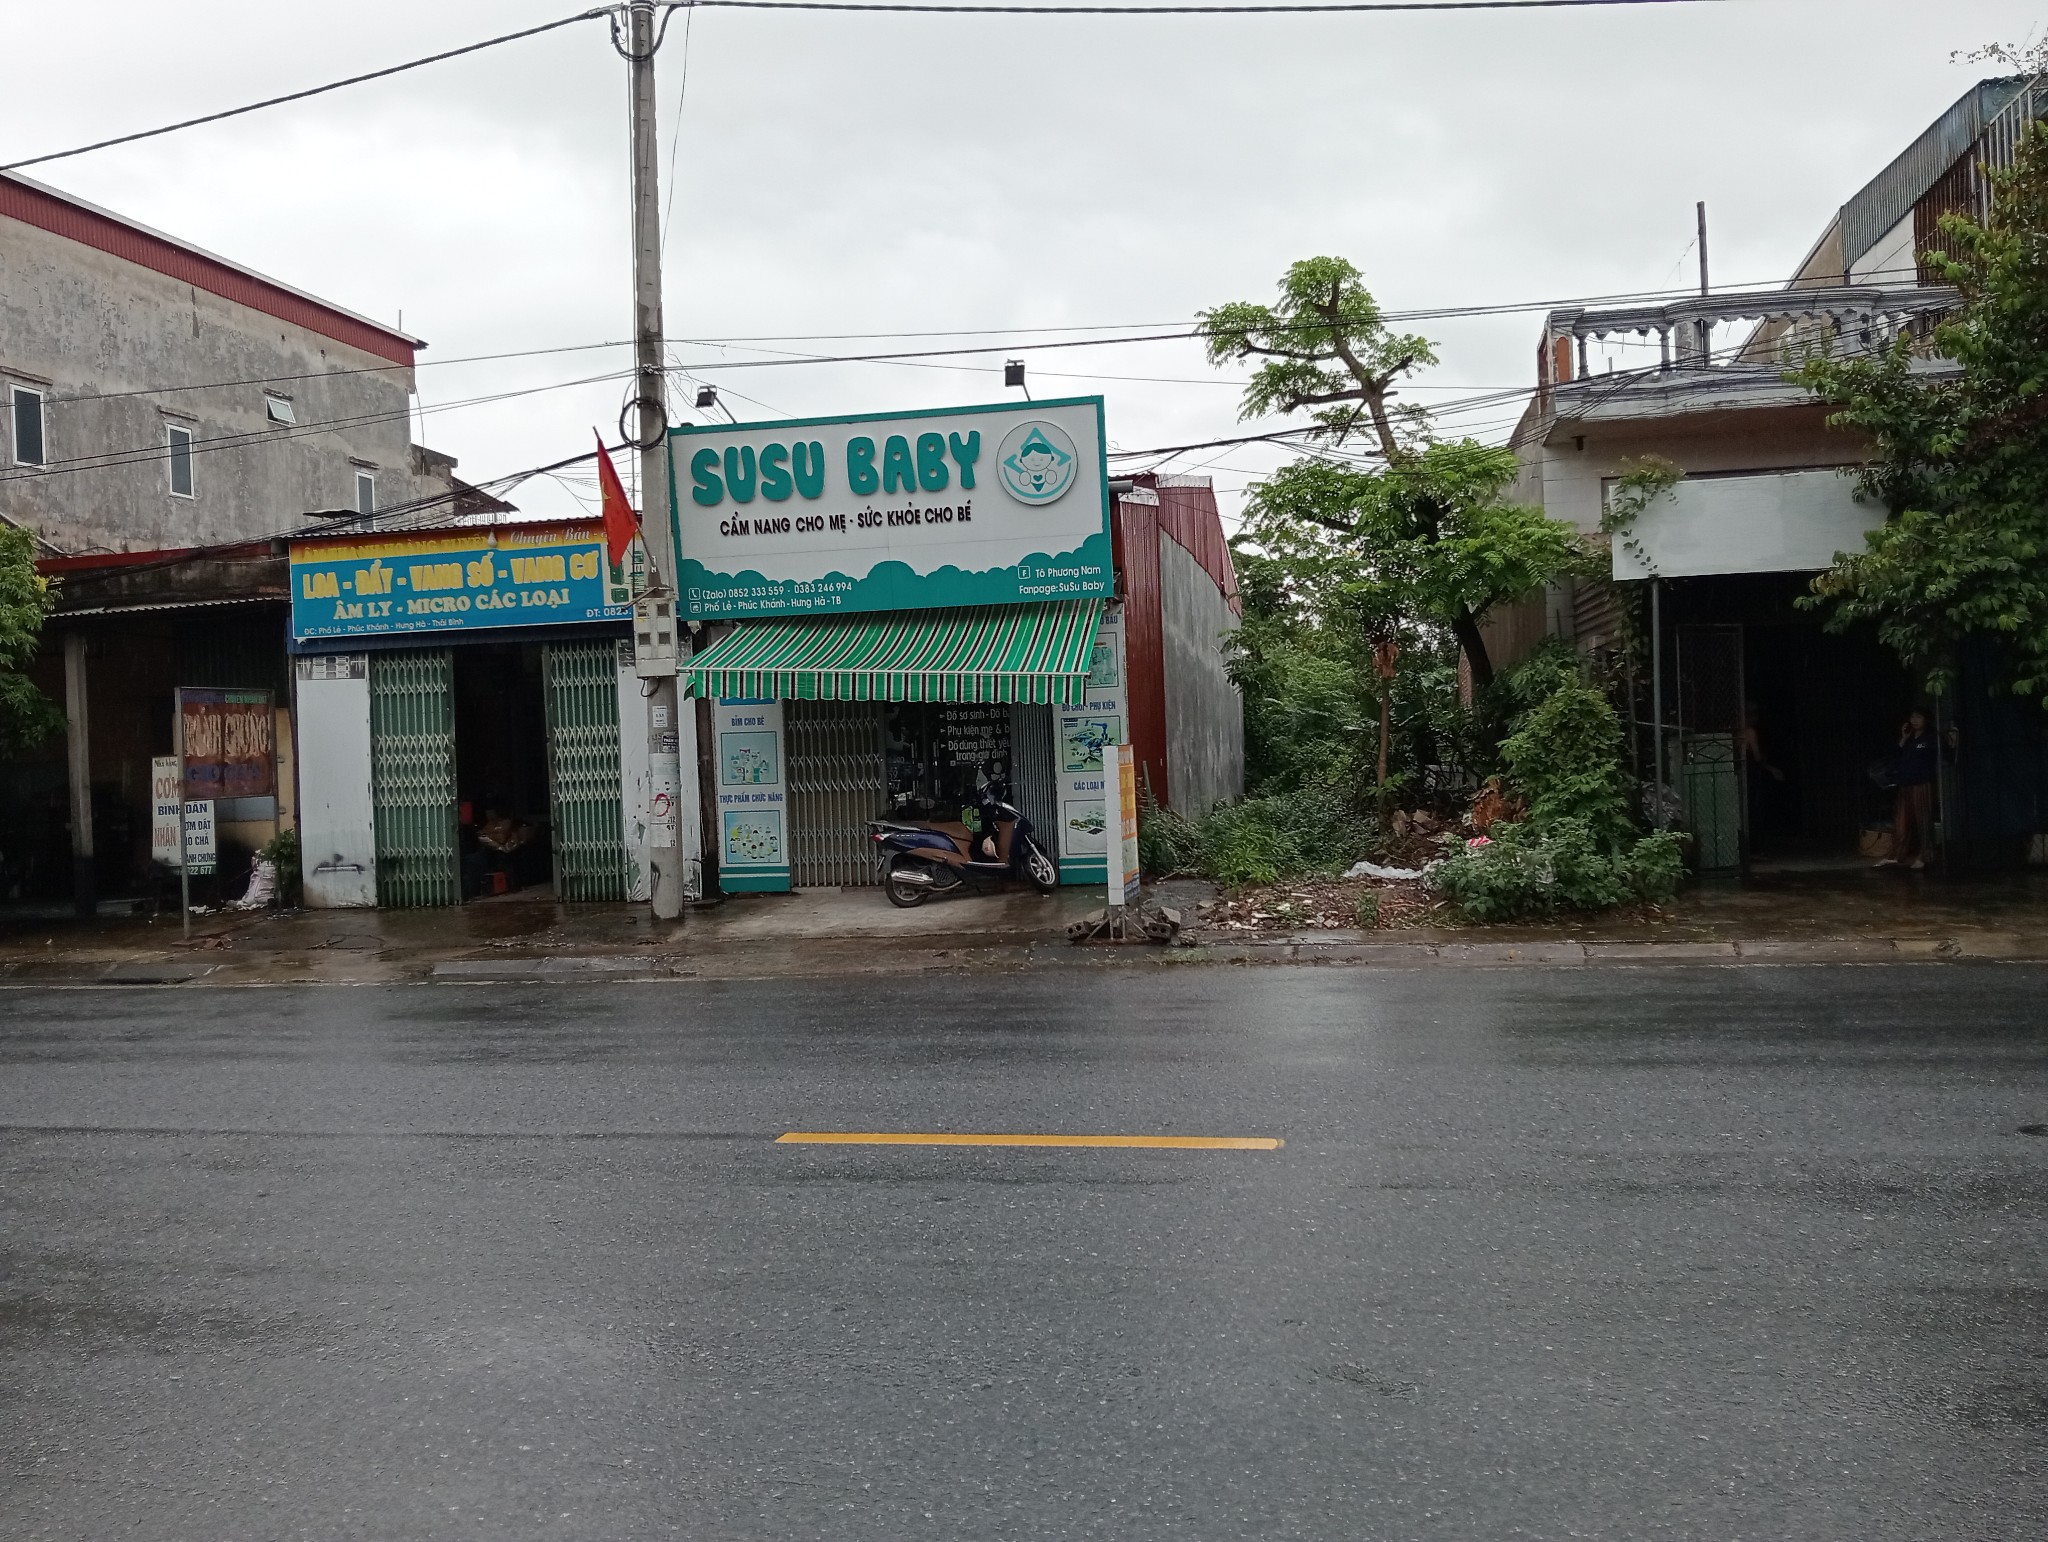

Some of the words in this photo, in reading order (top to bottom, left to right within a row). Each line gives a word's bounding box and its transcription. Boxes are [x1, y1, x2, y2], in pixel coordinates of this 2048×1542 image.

[690, 440, 826, 506] SUSU
[846, 430, 982, 496] BABY
[719, 510, 750, 536] CẨM
[754, 517, 792, 535] NANG
[795, 514, 825, 533] CHO
[829, 513, 847, 534] MẸ
[857, 505, 883, 528] SỨC
[887, 502, 921, 526] KHỎE
[924, 506, 954, 524] CHO
[957, 500, 972, 522] BÉ
[510, 531, 557, 545] Chuyên
[562, 527, 590, 540] Bán
[303, 571, 340, 600] LOA
[409, 562, 464, 592] VANG
[467, 551, 495, 588] SỐ
[510, 554, 566, 585] VANG
[569, 550, 599, 580] CƠ
[1047, 567, 1080, 578] Phương
[1080, 565, 1101, 576] Nam
[702, 589, 727, 600] (Zalo)
[728, 589, 749, 598] 0852
[751, 588, 767, 597] 333
[768, 586, 784, 596] 559
[794, 584, 816, 594] 0383
[818, 583, 834, 592] 246
[836, 581, 852, 591] 994
[1083, 581, 1105, 592] Baby
[333, 600, 363, 620] ÂM
[367, 600, 393, 617] LY
[407, 595, 471, 615] MICRO
[475, 589, 516, 610] CÁC
[520, 588, 570, 608] LOẠI
[704, 600, 720, 612] Phố
[738, 598, 758, 610] Phúc
[760, 597, 785, 609] Khánh
[814, 596, 826, 606] Hà
[831, 595, 842, 605] TB
[586, 608, 601, 618] ĐT:
[347, 624, 365, 633] Phúc
[366, 622, 389, 632] Khánh
[970, 709, 985, 719] sinh
[947, 725, 962, 738] Phụ
[956, 751, 976, 761] trong
[1074, 780, 1085, 791] CÁC
[1086, 781, 1099, 792] LOẠI
[185, 802, 208, 814] DÂN
